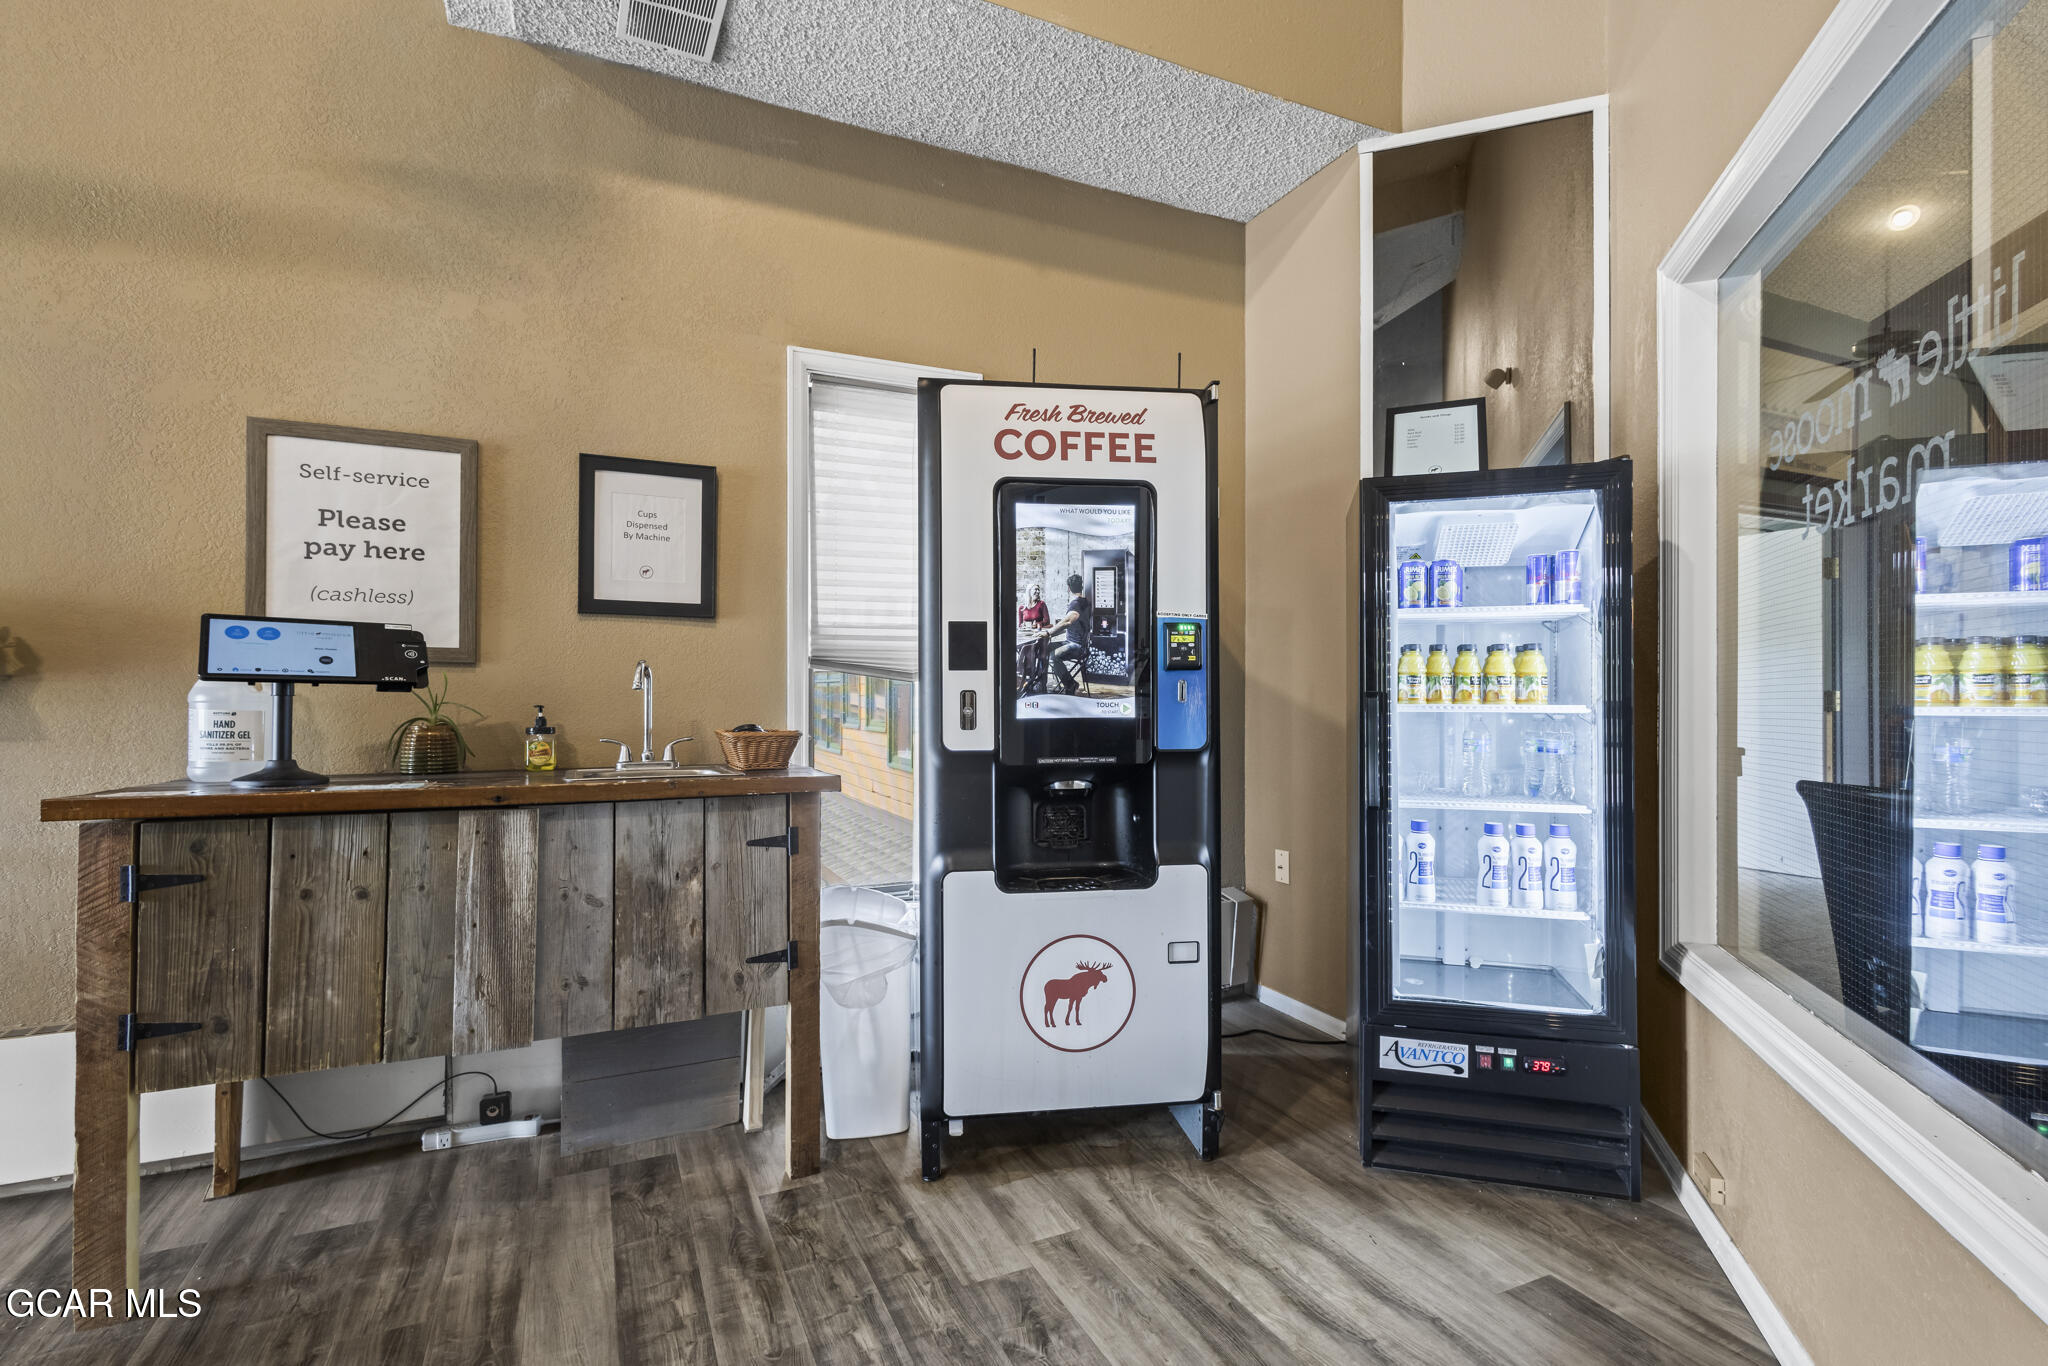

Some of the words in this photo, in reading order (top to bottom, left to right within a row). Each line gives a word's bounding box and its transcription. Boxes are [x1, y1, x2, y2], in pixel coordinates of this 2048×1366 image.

[1004, 402, 1063, 423] Fresh
[1066, 404, 1148, 425] Brewed
[993, 428, 1157, 464] COFFEE
[299, 463, 430, 488] Self-service
[317, 508, 407, 532] Please
[637, 510, 658, 519] Cups
[626, 520, 668, 531] Dispensed
[623, 531, 633, 540] By
[635, 532, 671, 542] Machine
[303, 540, 356, 561] pay
[363, 540, 426, 561] here
[310, 585, 414, 606] (cashless)
[200, 731, 235, 739] SANITIZER
[238, 731, 252, 739] GEL
[213, 720, 236, 729] HAND
[1382, 1040, 1466, 1070] AVANTCO
[1417, 1042, 1465, 1052] REFRIGERATION
